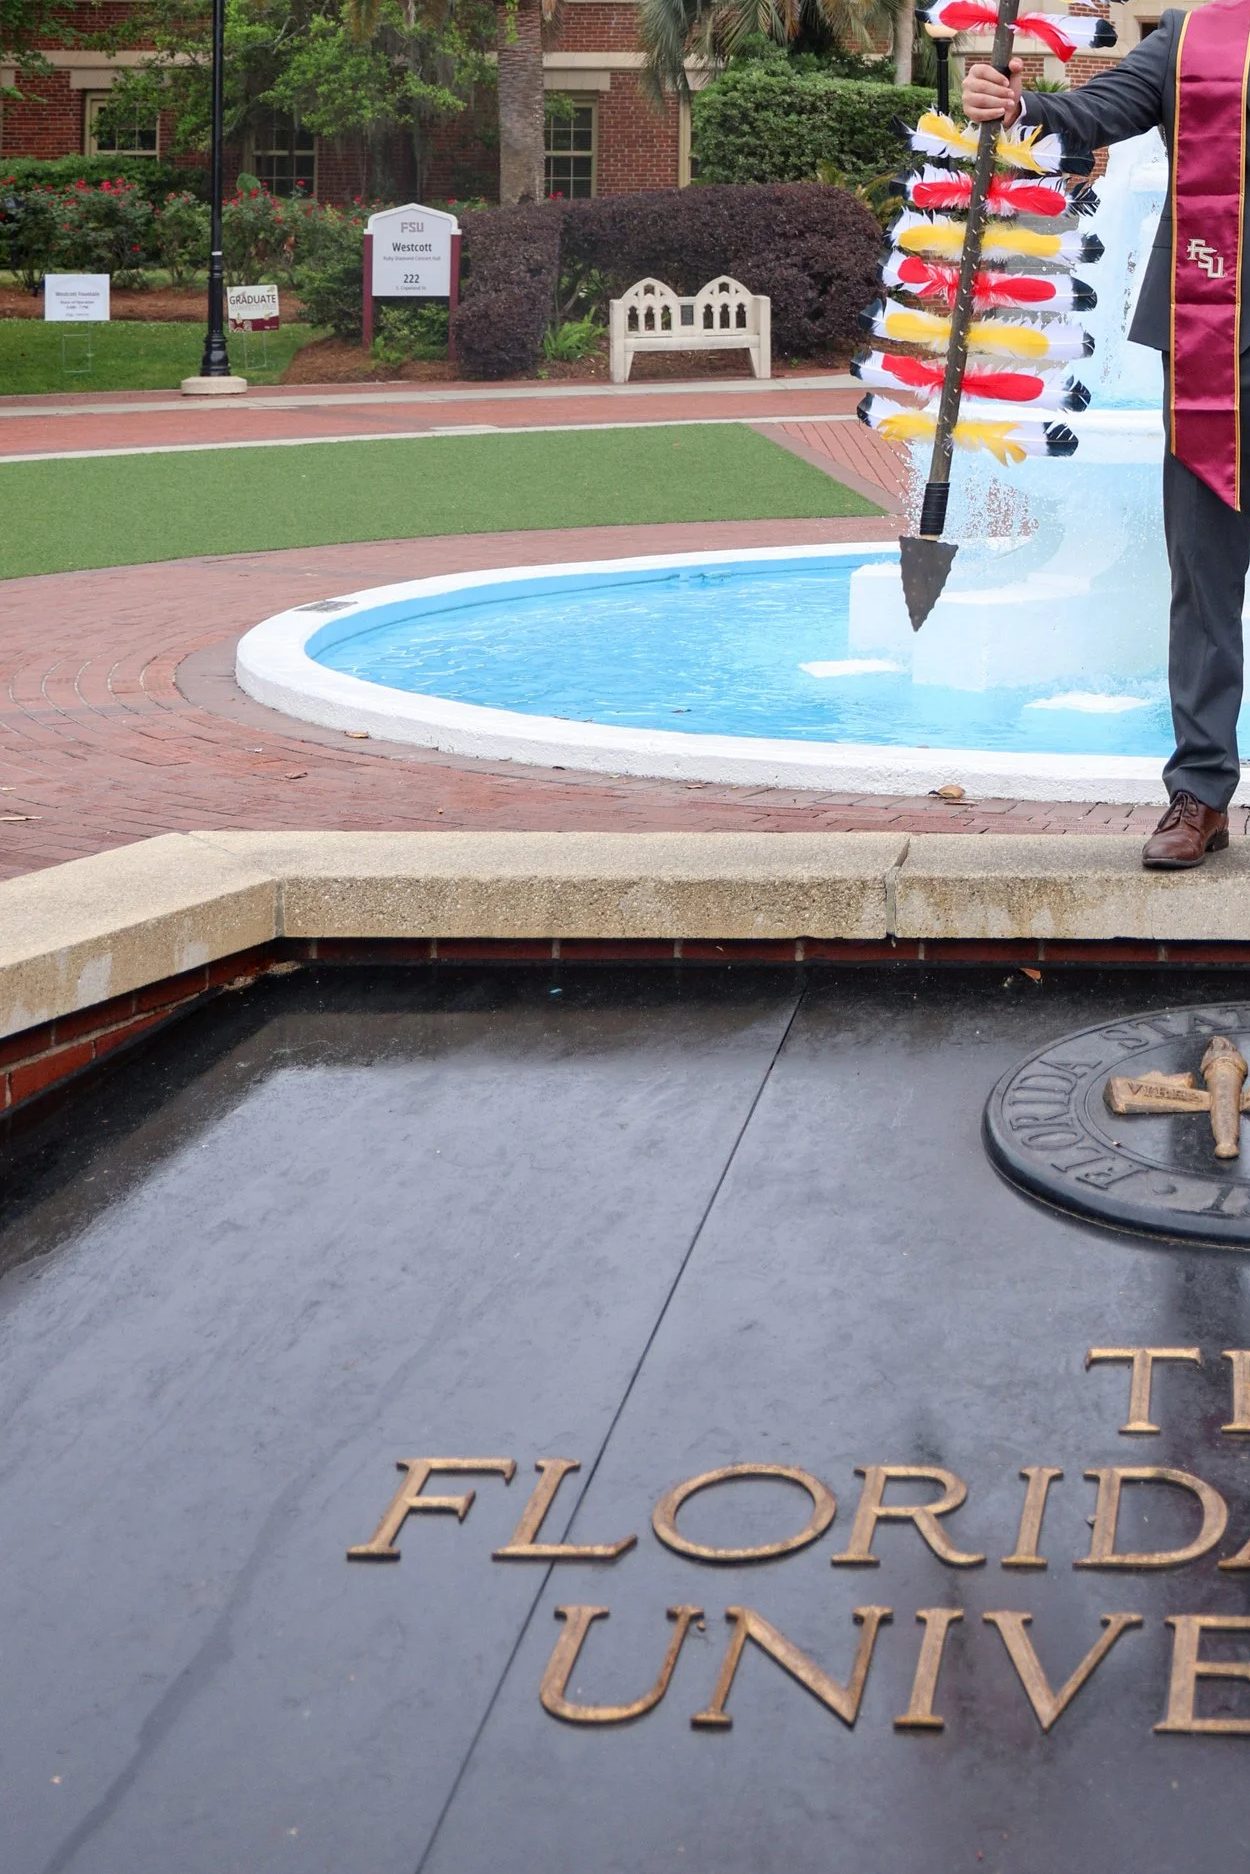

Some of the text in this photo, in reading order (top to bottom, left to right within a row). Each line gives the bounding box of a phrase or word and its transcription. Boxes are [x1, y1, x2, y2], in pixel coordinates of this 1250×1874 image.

[400, 221, 424, 234] FSU
[392, 242, 432, 252] Westcott
[1187, 238, 1225, 278] FSU
[403, 273, 420, 284] 222
[229, 294, 276, 305] GRADUATE
[1127, 1082, 1204, 1103] VIRES
